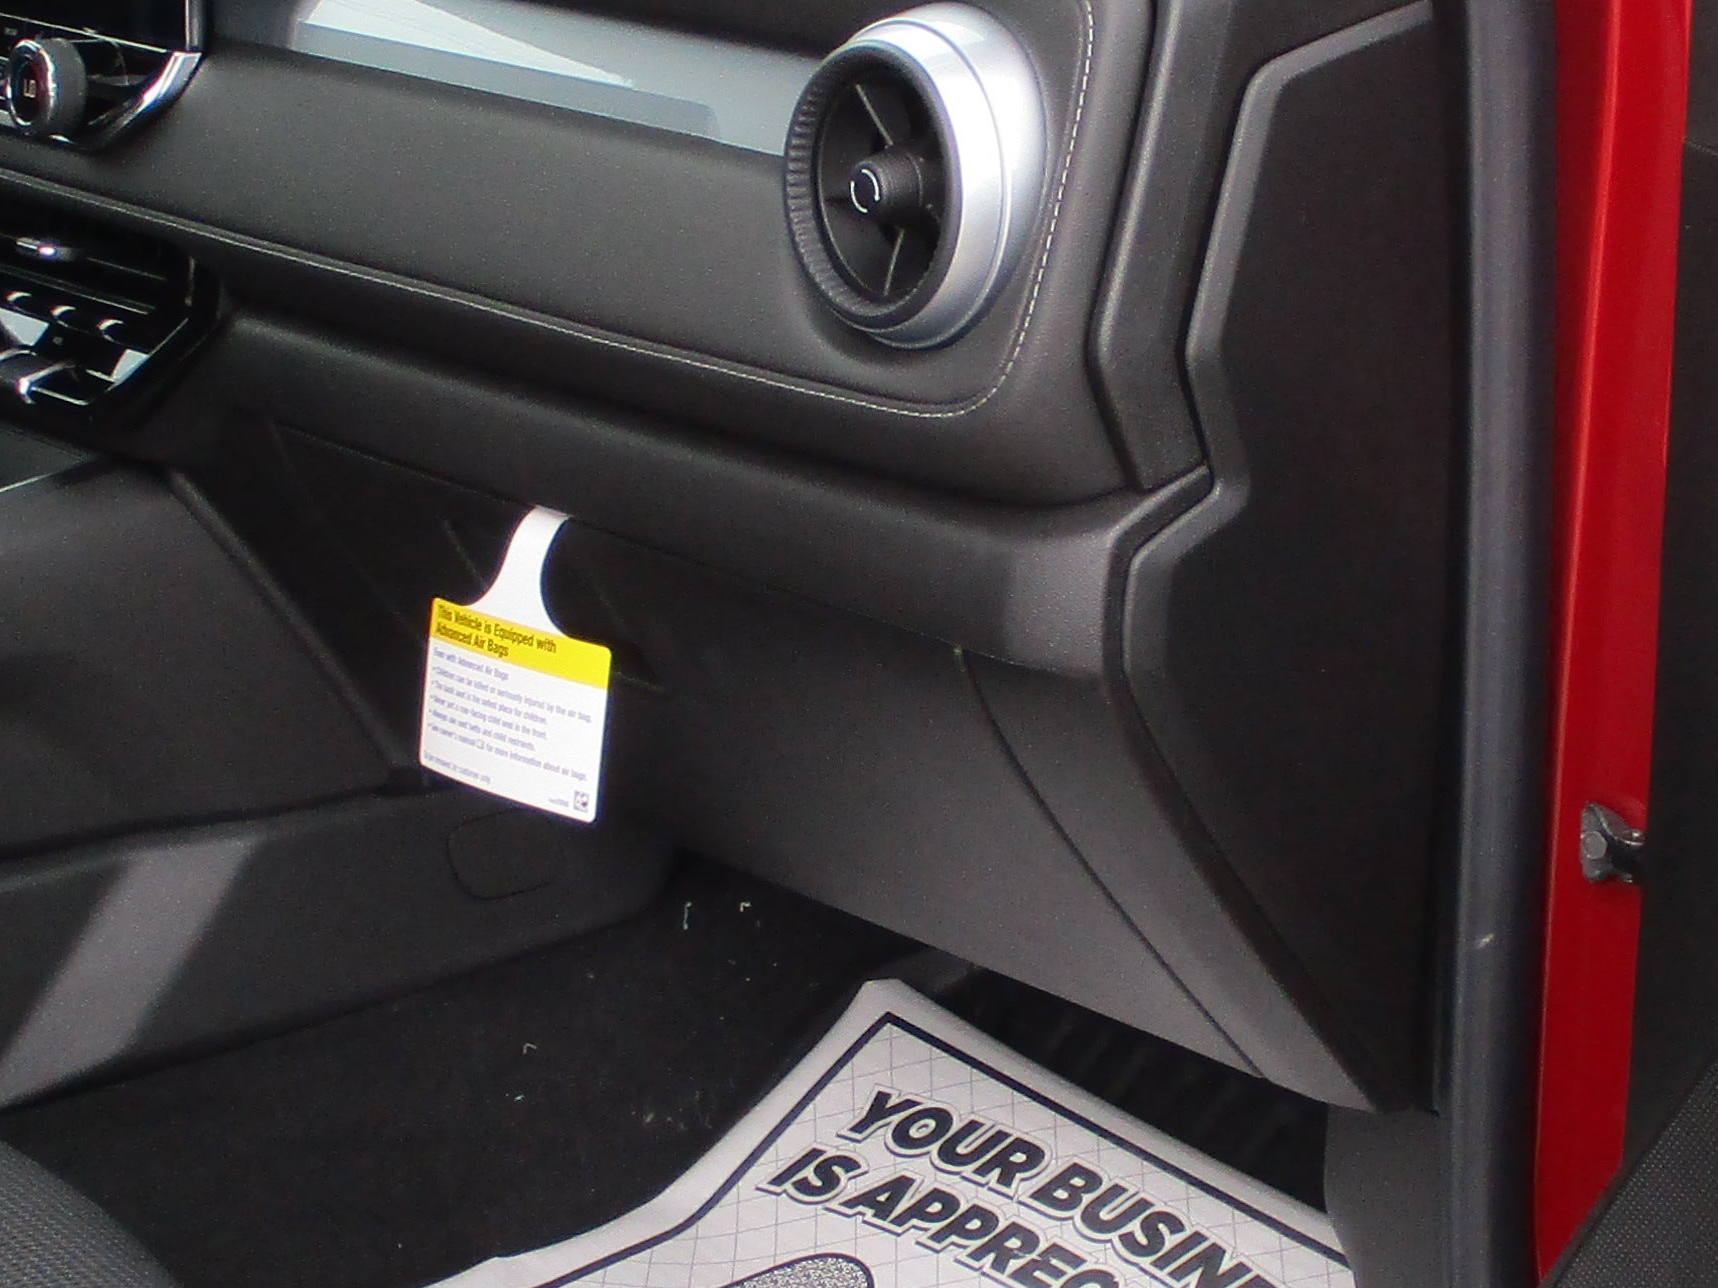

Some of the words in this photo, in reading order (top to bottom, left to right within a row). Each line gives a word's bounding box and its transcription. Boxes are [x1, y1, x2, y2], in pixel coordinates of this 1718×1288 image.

[454, 611, 482, 633] Vehicle
[484, 620, 492, 635] is
[494, 623, 535, 647] Equipped
[536, 636, 557, 654] with
[474, 634, 486, 648] Air
[487, 637, 510, 658] Bags
[841, 1085, 1053, 1195] YOUR
[758, 1146, 868, 1204] IS
